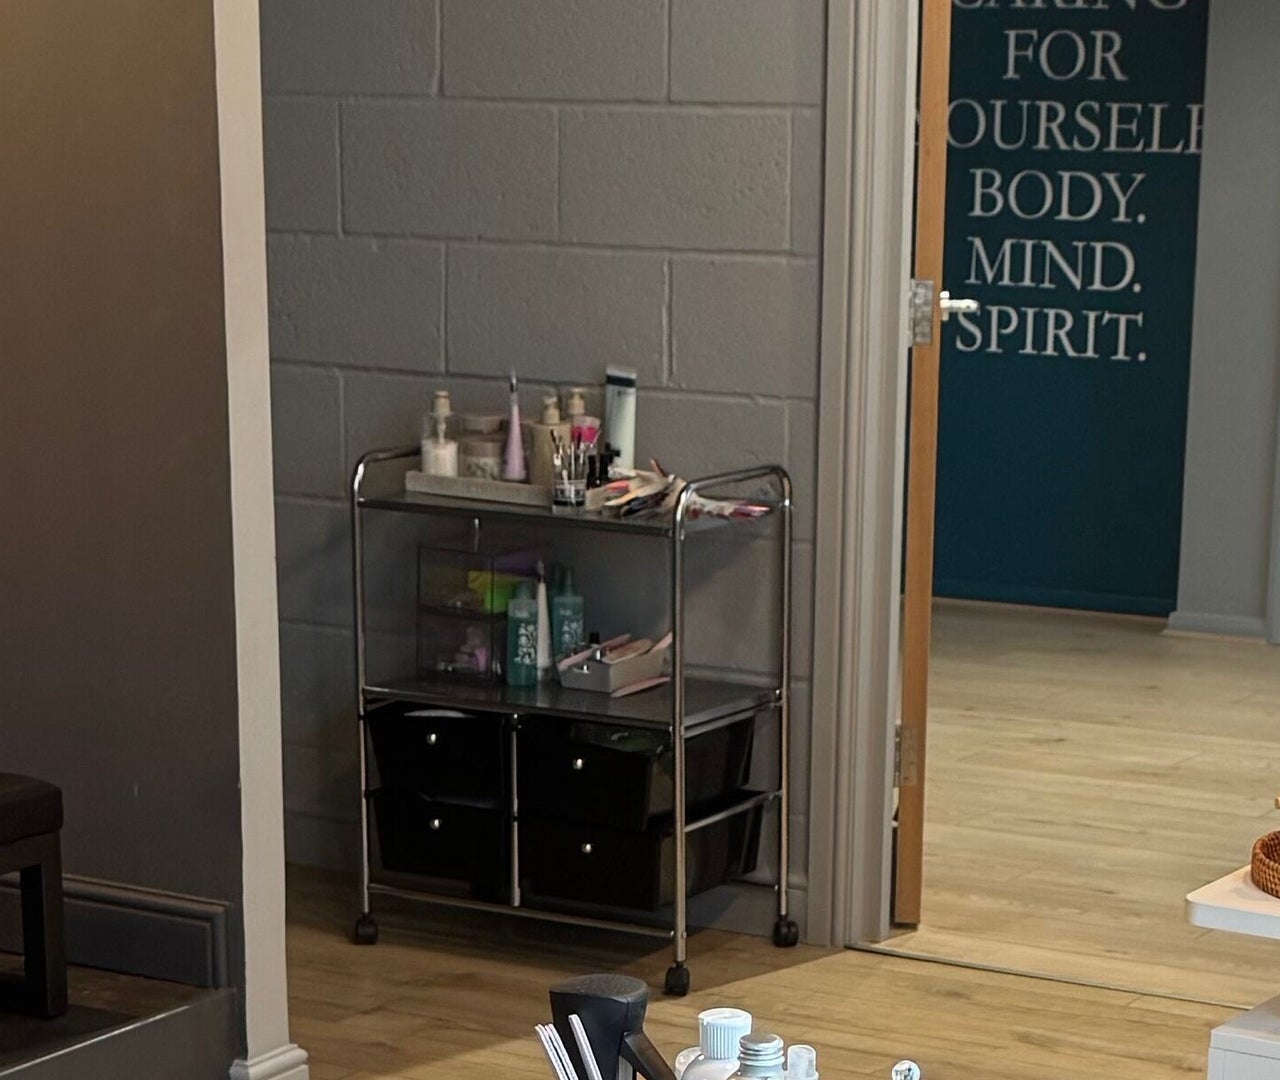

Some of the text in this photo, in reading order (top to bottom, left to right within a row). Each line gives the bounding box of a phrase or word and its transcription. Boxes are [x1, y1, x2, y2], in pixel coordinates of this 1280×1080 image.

[1002, 29, 1129, 81] FOR
[968, 167, 1147, 225] BODY.
[964, 236, 1142, 293] MIND.
[955, 304, 1147, 361] SPIRIT.
